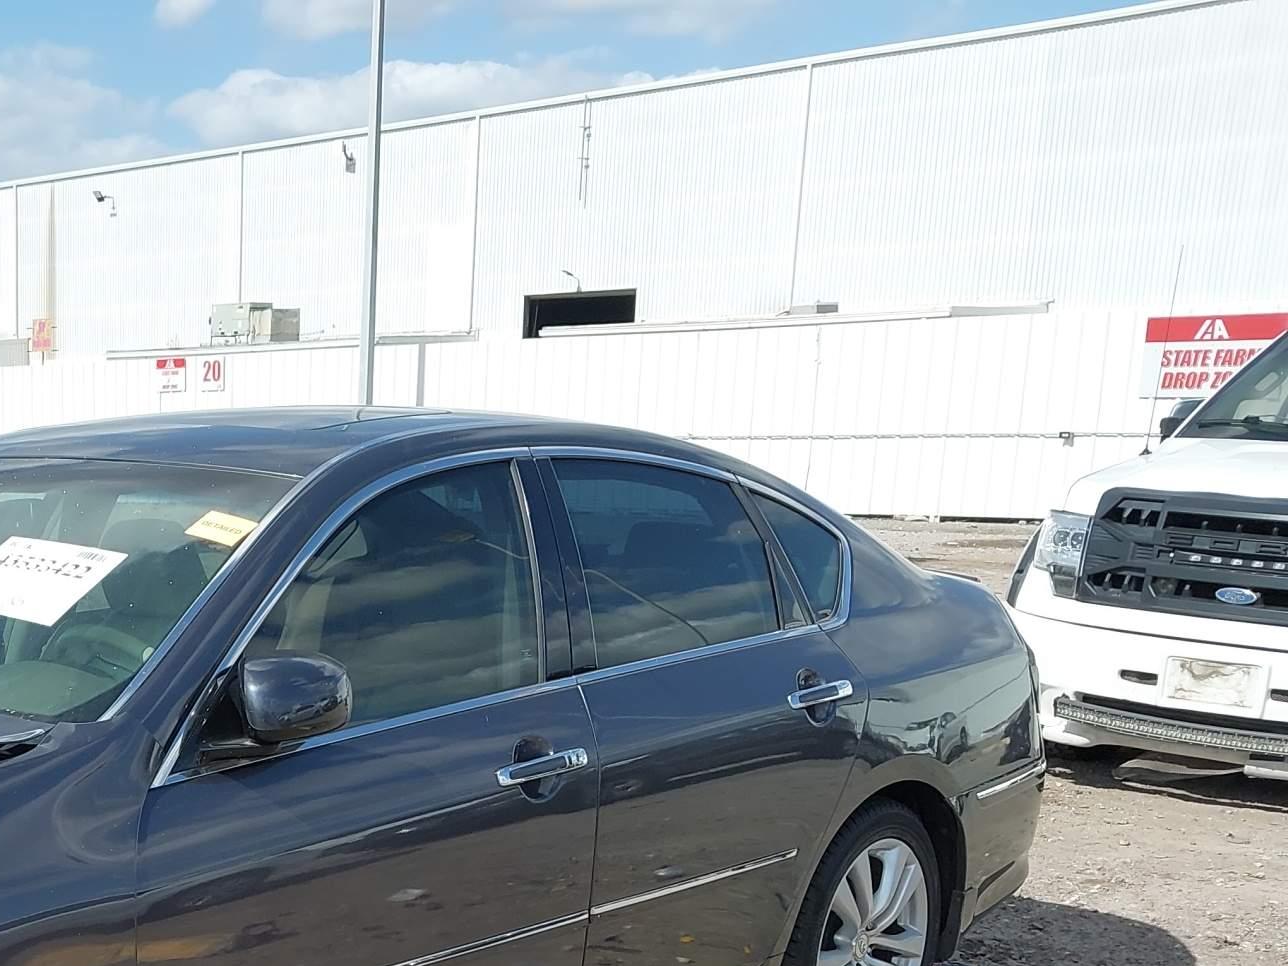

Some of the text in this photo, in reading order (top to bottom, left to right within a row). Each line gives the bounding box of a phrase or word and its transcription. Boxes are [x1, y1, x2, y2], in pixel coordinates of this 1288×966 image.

[1161, 349, 1212, 367] STATE
[203, 360, 221, 382] 20
[1161, 371, 1209, 390] DROP
